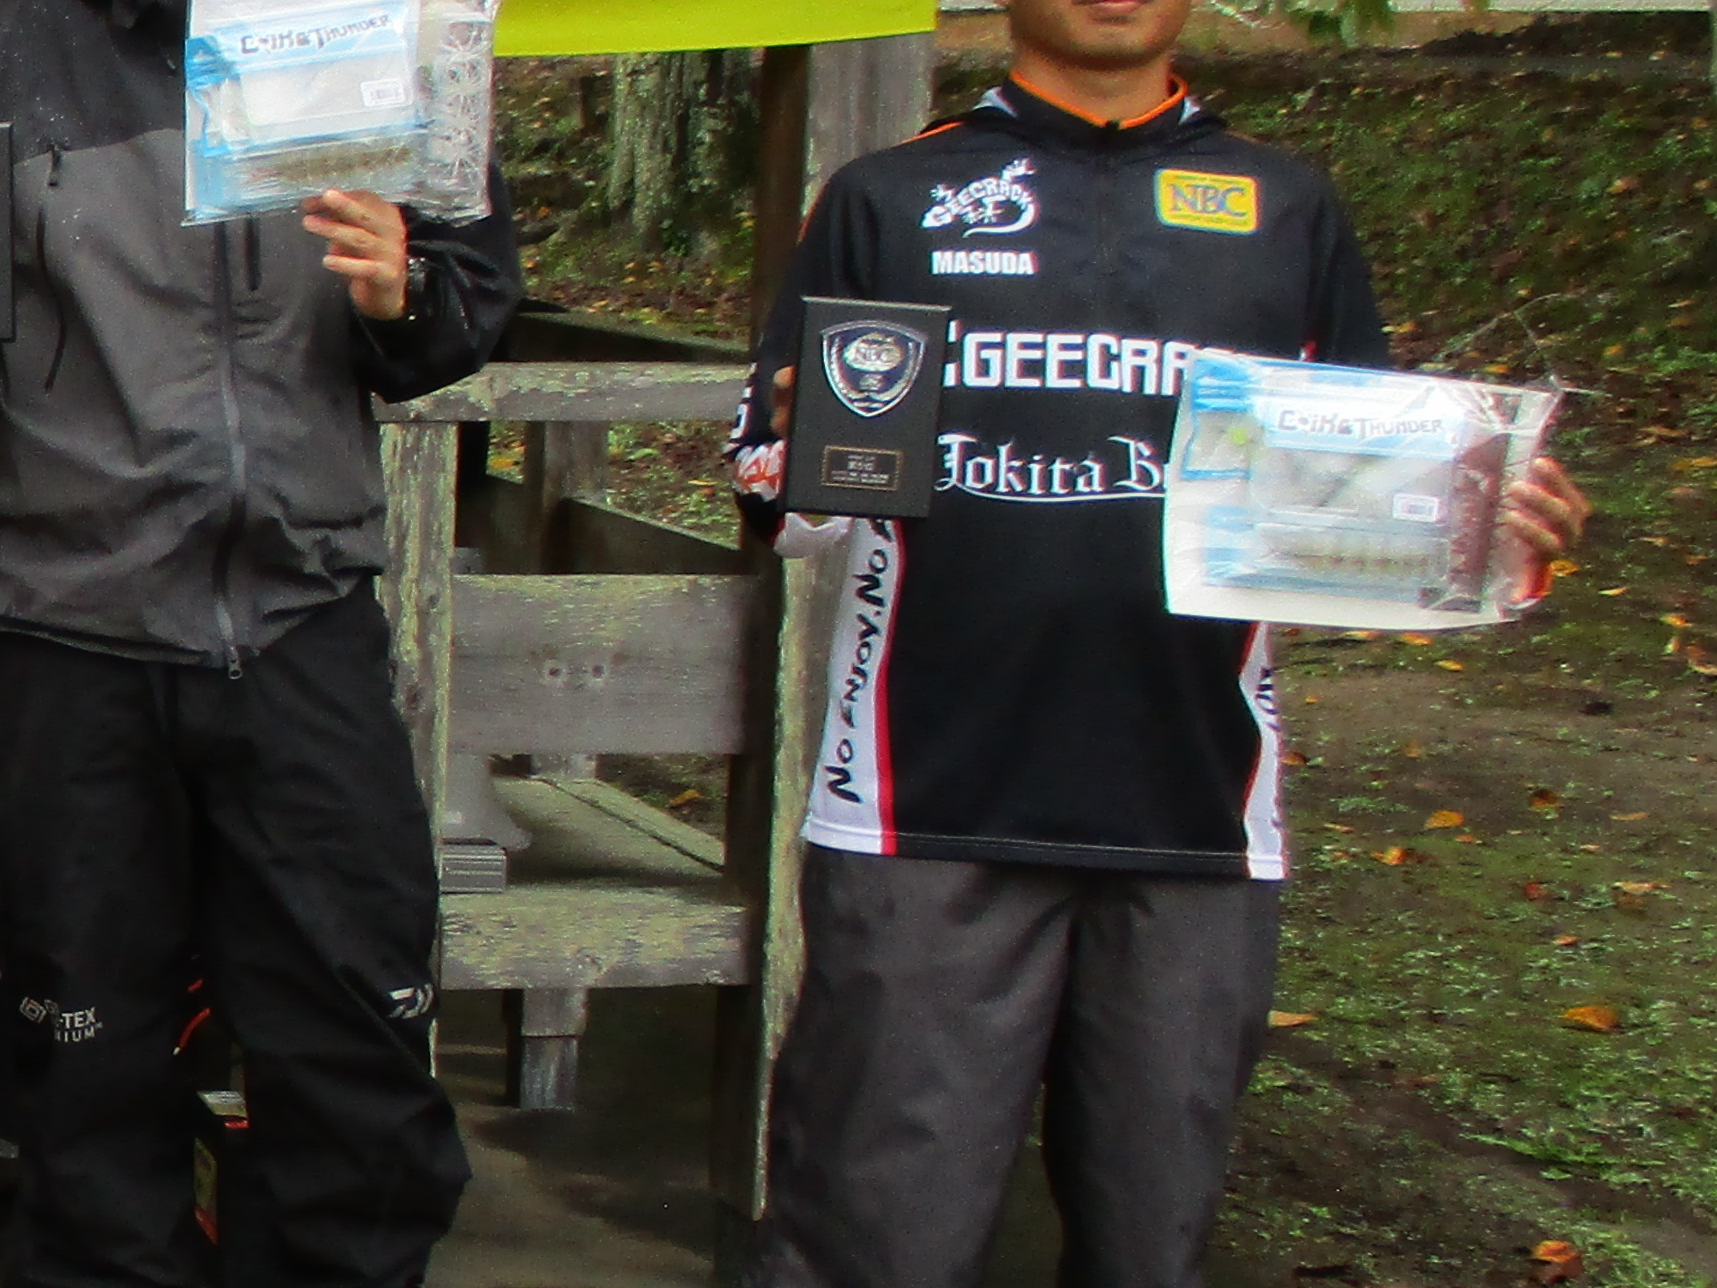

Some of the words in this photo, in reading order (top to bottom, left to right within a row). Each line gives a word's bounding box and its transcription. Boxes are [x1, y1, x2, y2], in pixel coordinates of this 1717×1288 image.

[1169, 183, 1248, 217] NBC
[932, 250, 1036, 274] MASUDA
[935, 432, 1106, 497] Tokita
[1107, 435, 1168, 491] B
